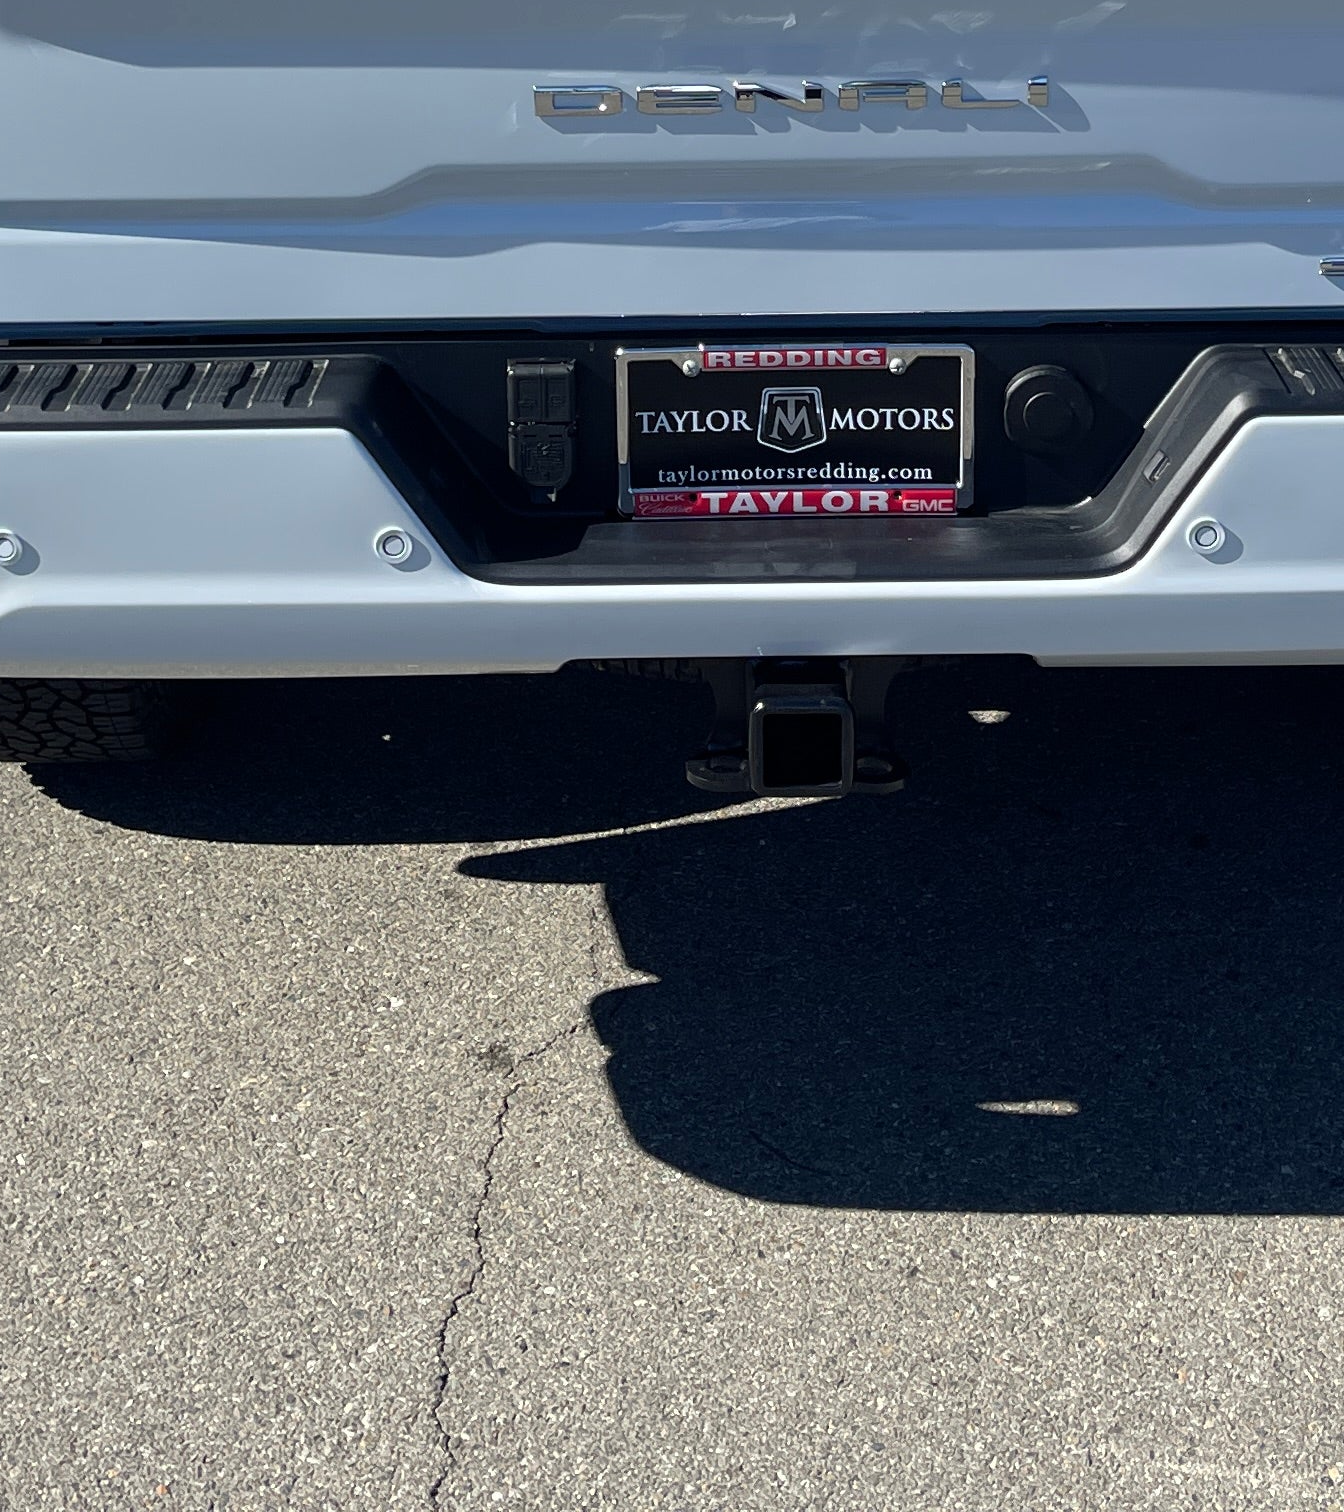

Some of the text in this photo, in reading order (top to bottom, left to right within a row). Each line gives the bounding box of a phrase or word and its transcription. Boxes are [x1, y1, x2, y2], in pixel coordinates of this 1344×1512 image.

[532, 74, 1050, 118] DENALI
[707, 349, 882, 368] REDDING
[635, 407, 955, 435] TAYLOR MOTORS
[658, 462, 934, 486] taylormotorsredding.com
[639, 494, 685, 503] BUICK
[700, 491, 891, 514] TAYLOR
[902, 499, 954, 512] GMC
